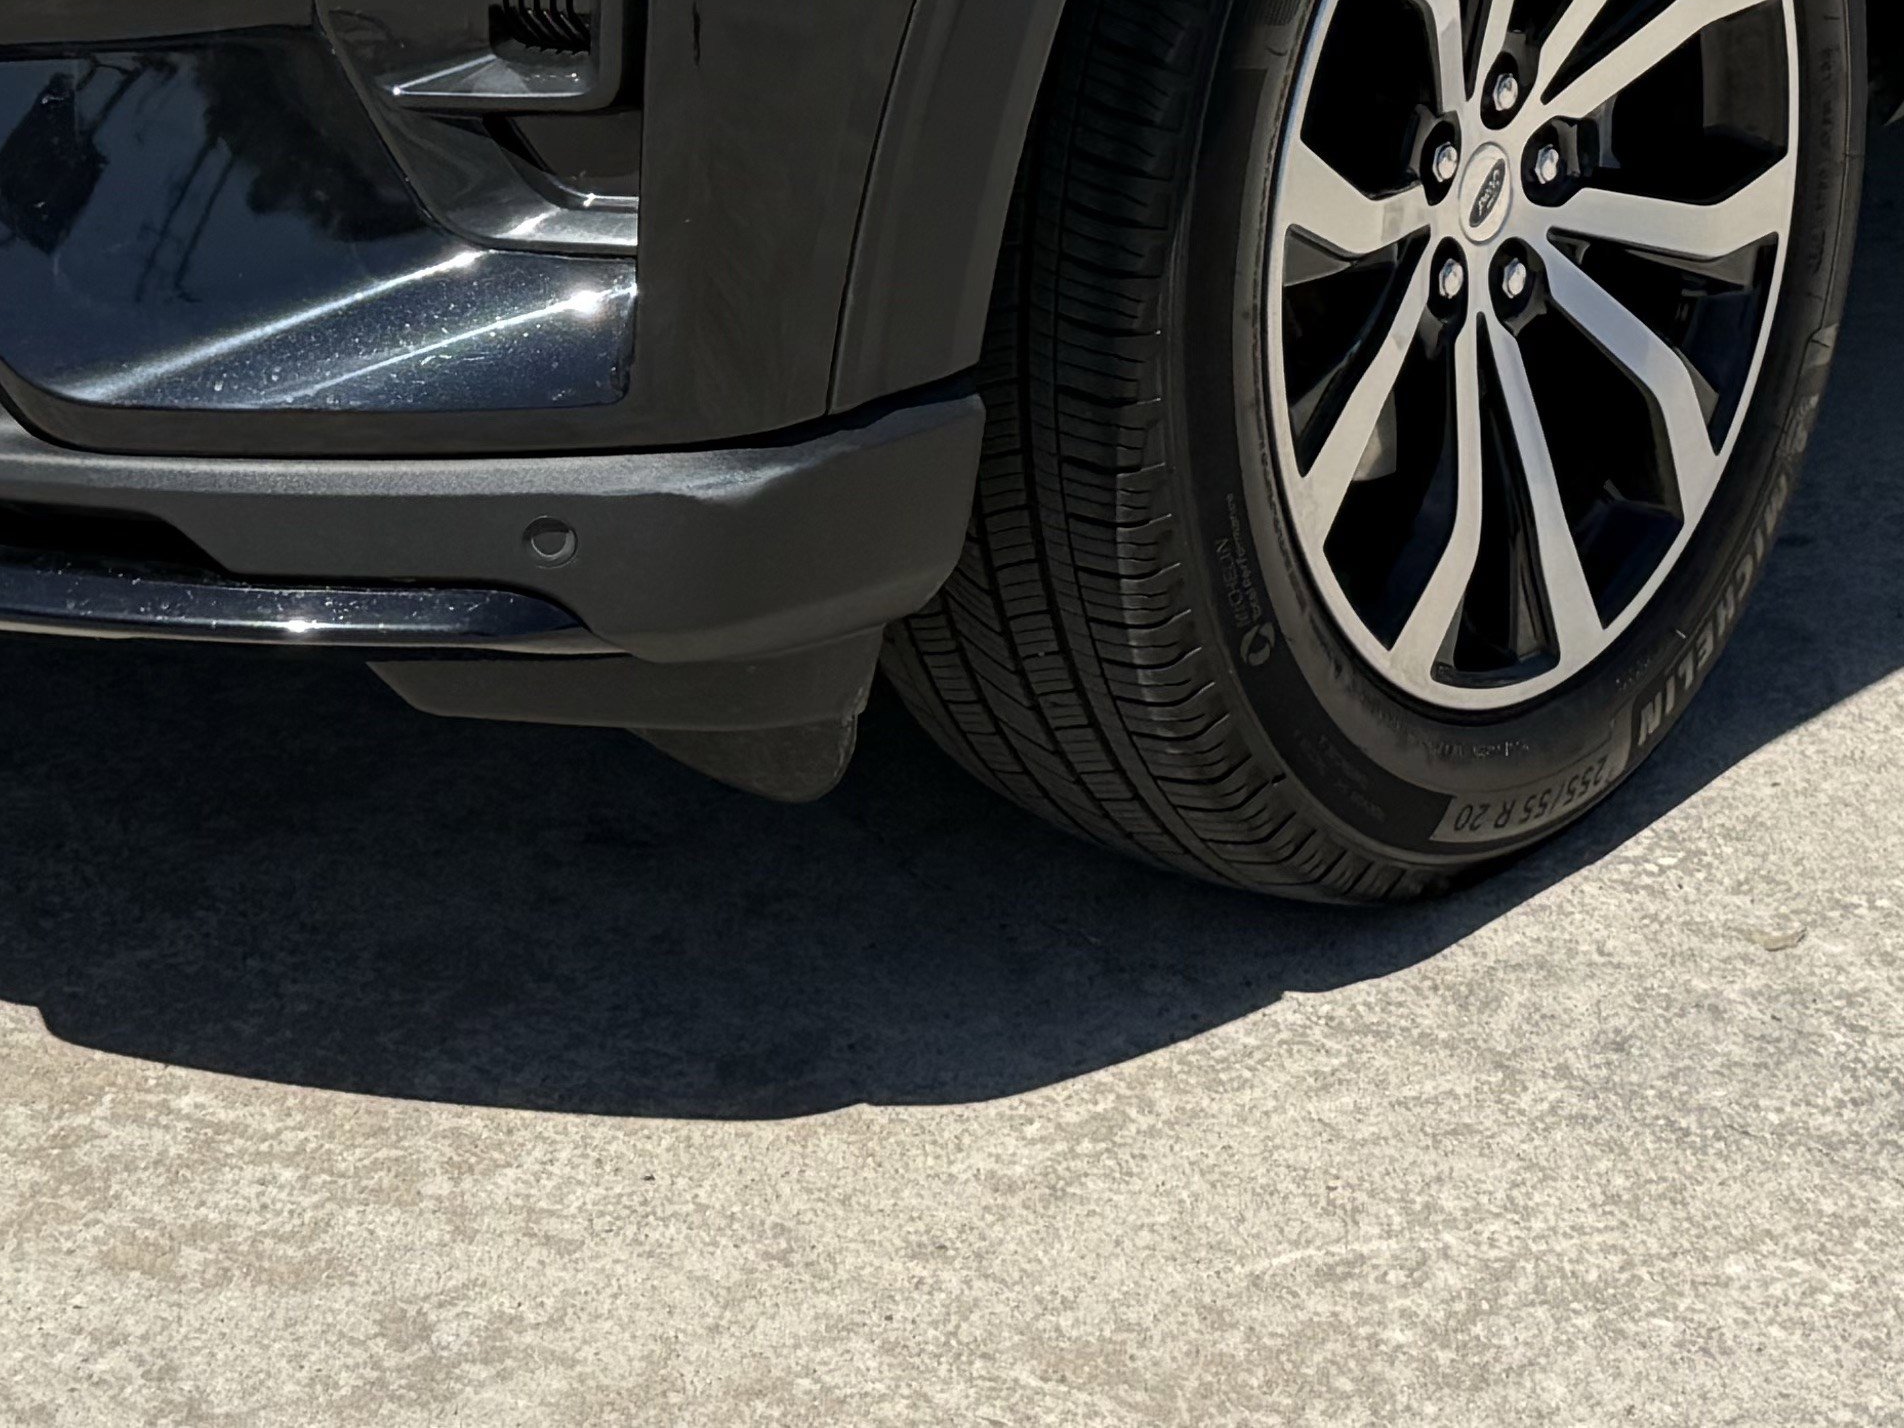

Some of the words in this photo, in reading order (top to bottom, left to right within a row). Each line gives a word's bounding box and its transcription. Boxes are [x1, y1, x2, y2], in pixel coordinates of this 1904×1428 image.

[1637, 473, 1788, 746] MICHELIN
[1519, 754, 1609, 824] 255/55
[1453, 803, 1491, 832] 20
[1493, 806, 1515, 829] R
